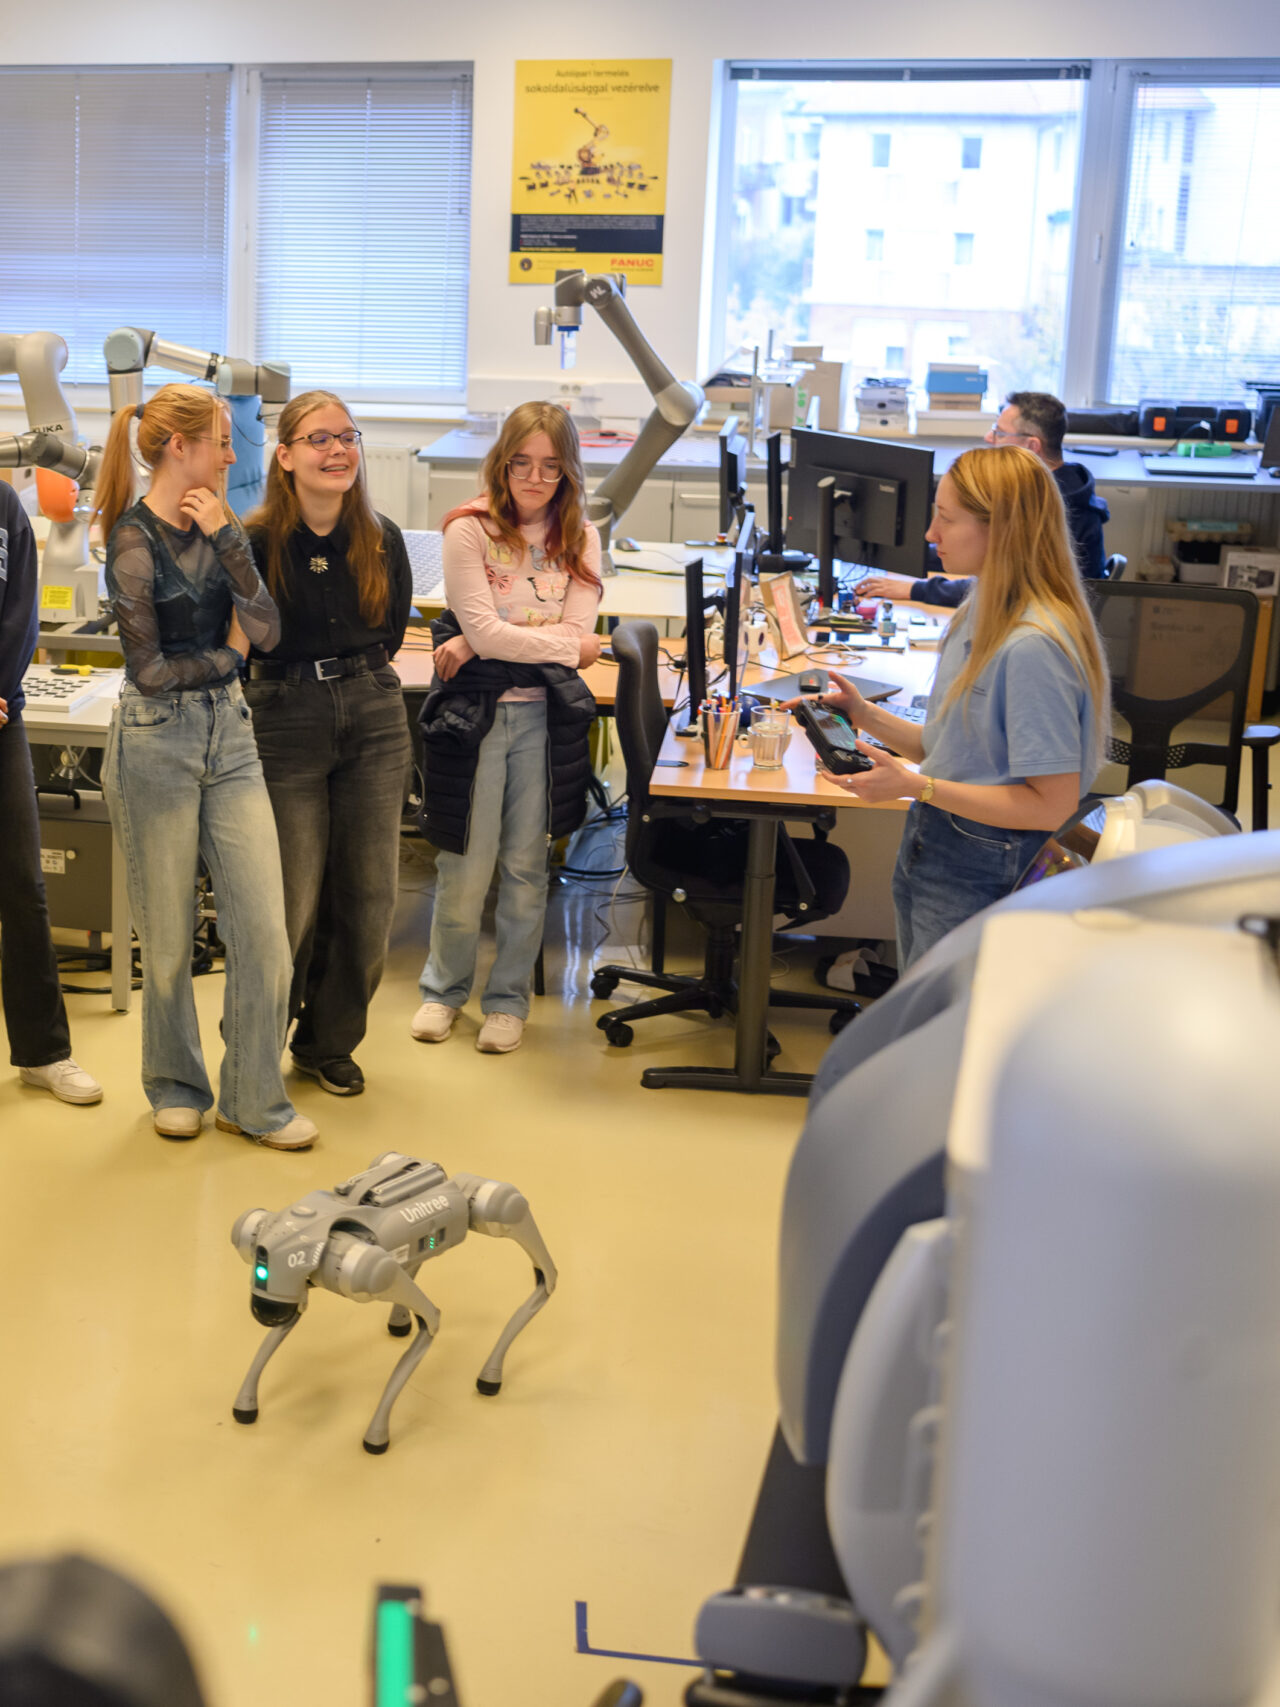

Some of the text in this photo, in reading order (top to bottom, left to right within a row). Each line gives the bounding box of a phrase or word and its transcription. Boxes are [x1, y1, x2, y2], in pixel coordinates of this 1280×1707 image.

[611, 82, 660, 93] vezérelve
[610, 258, 654, 267] FANUC
[399, 1195, 450, 1223] Unitree
[287, 1251, 306, 1267] 02
